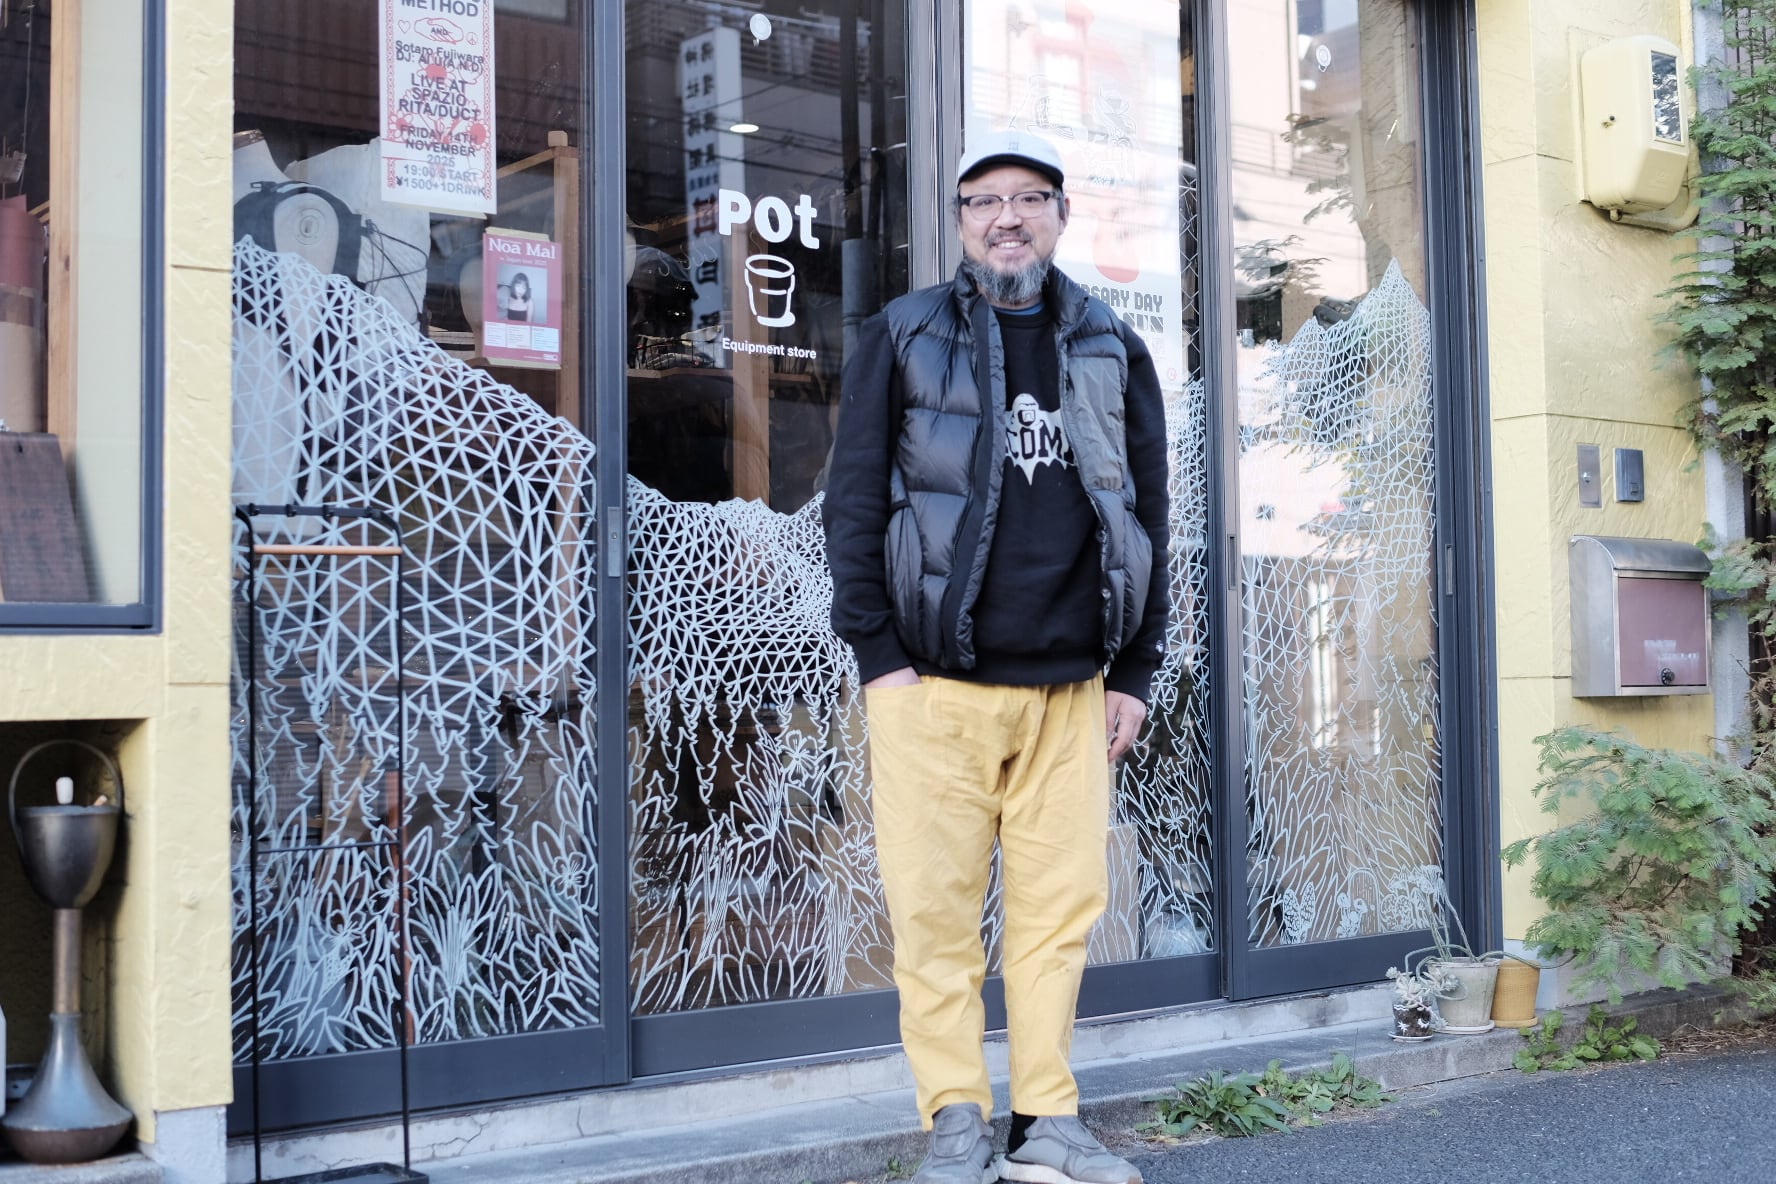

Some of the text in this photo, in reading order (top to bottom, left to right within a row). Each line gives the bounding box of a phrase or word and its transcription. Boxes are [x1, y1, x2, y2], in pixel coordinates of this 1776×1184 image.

[431, 27, 448, 36] AND
[395, 40, 484, 64] Sotaro Fujiwara
[396, 49, 415, 62] DJ:
[411, 73, 468, 93] LIVE AT
[412, 87, 467, 107] SPAZIO
[399, 98, 480, 121] RITA/DUCT
[401, 125, 478, 144] FRIDAY 14TH
[406, 139, 476, 157] NOVEMBER
[427, 154, 456, 167] 2025
[404, 164, 478, 182] 19:00 START
[488, 237, 556, 259] Noa Mal
[1134, 291, 1163, 313] DAY
[1122, 312, 1164, 334] SUN
[722, 337, 817, 360] Equipment store
